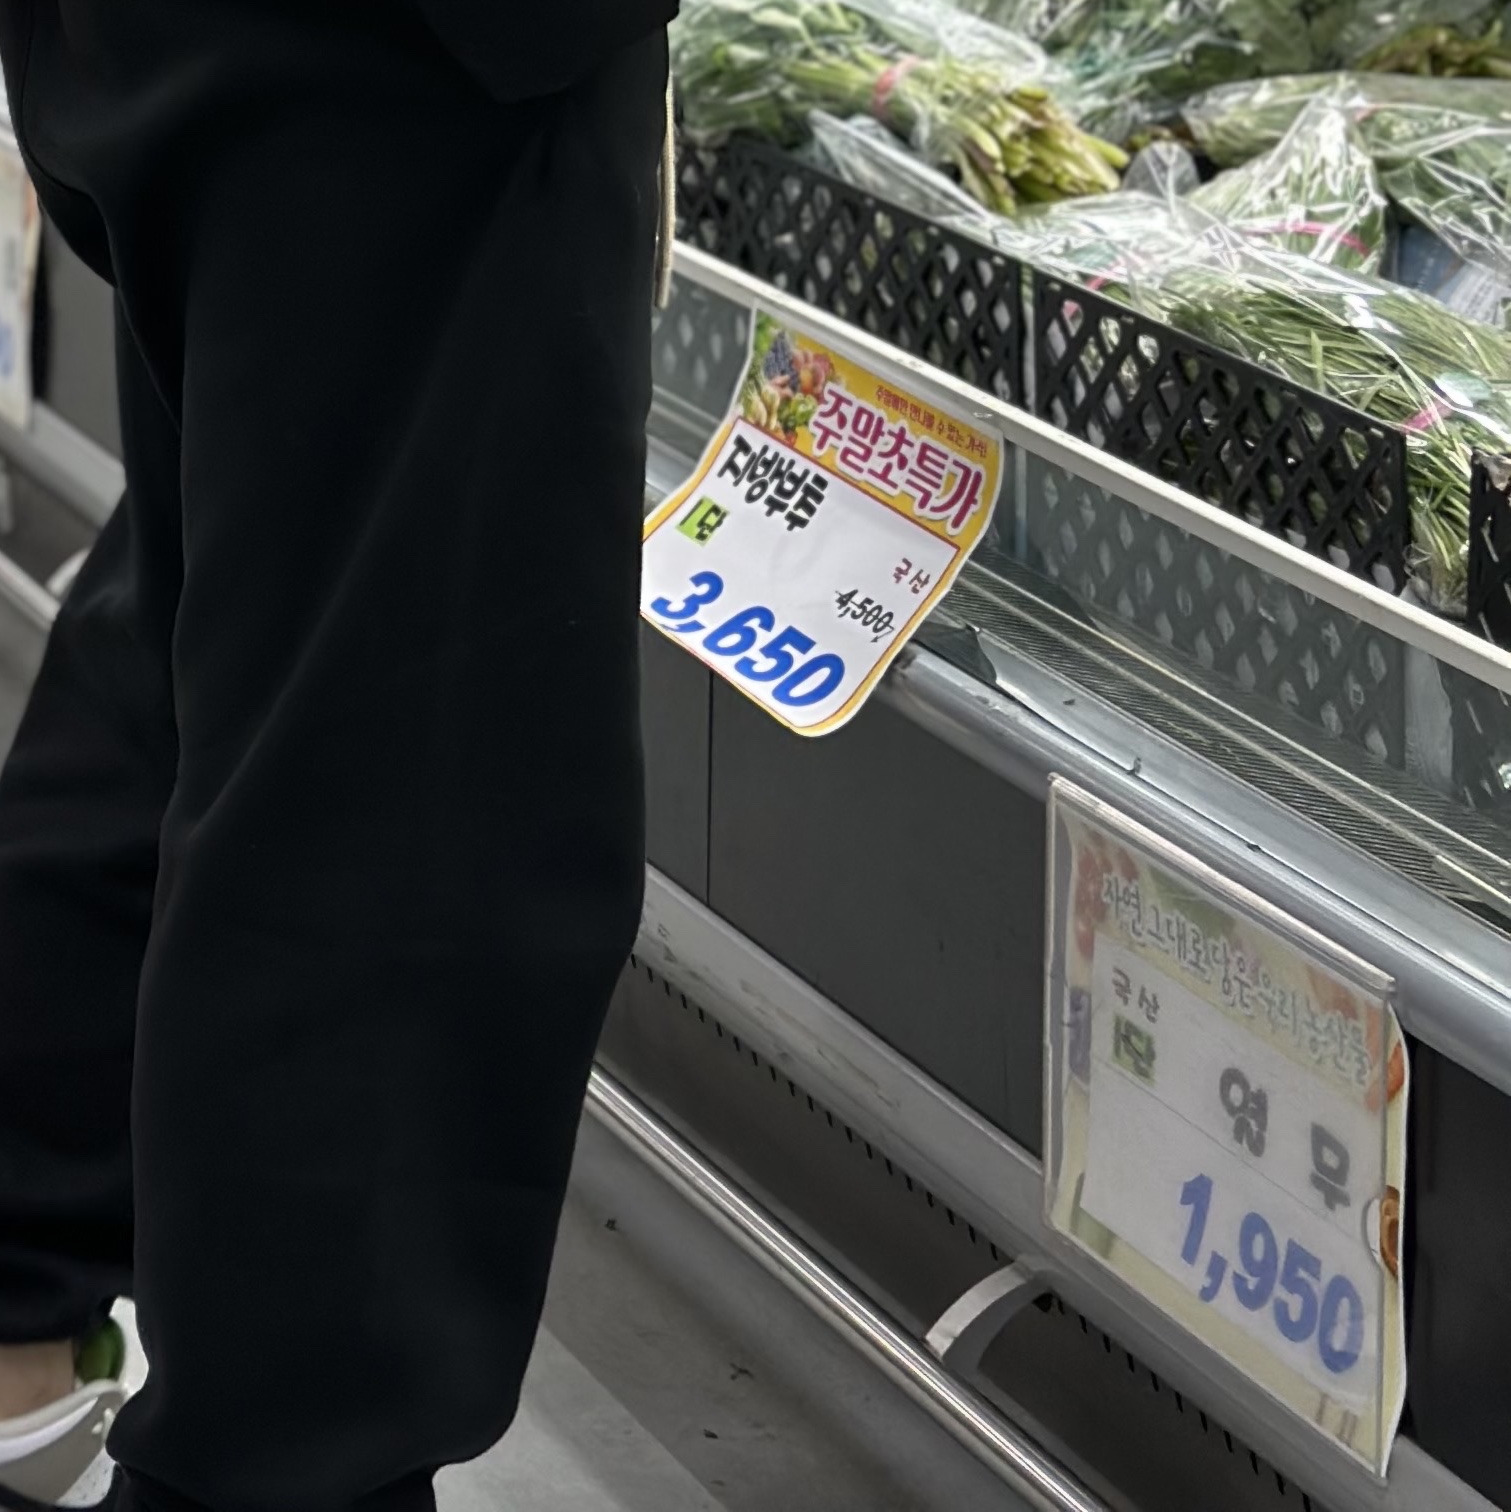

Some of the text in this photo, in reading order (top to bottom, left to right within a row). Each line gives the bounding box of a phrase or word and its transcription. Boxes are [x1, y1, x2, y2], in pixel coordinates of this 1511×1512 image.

[716, 433, 829, 532] 지방부추
[812, 388, 984, 530] 주말초특가
[650, 570, 846, 708] 3,650
[834, 588, 895, 634] 4,500
[1179, 1172, 1365, 1374] 1,950
